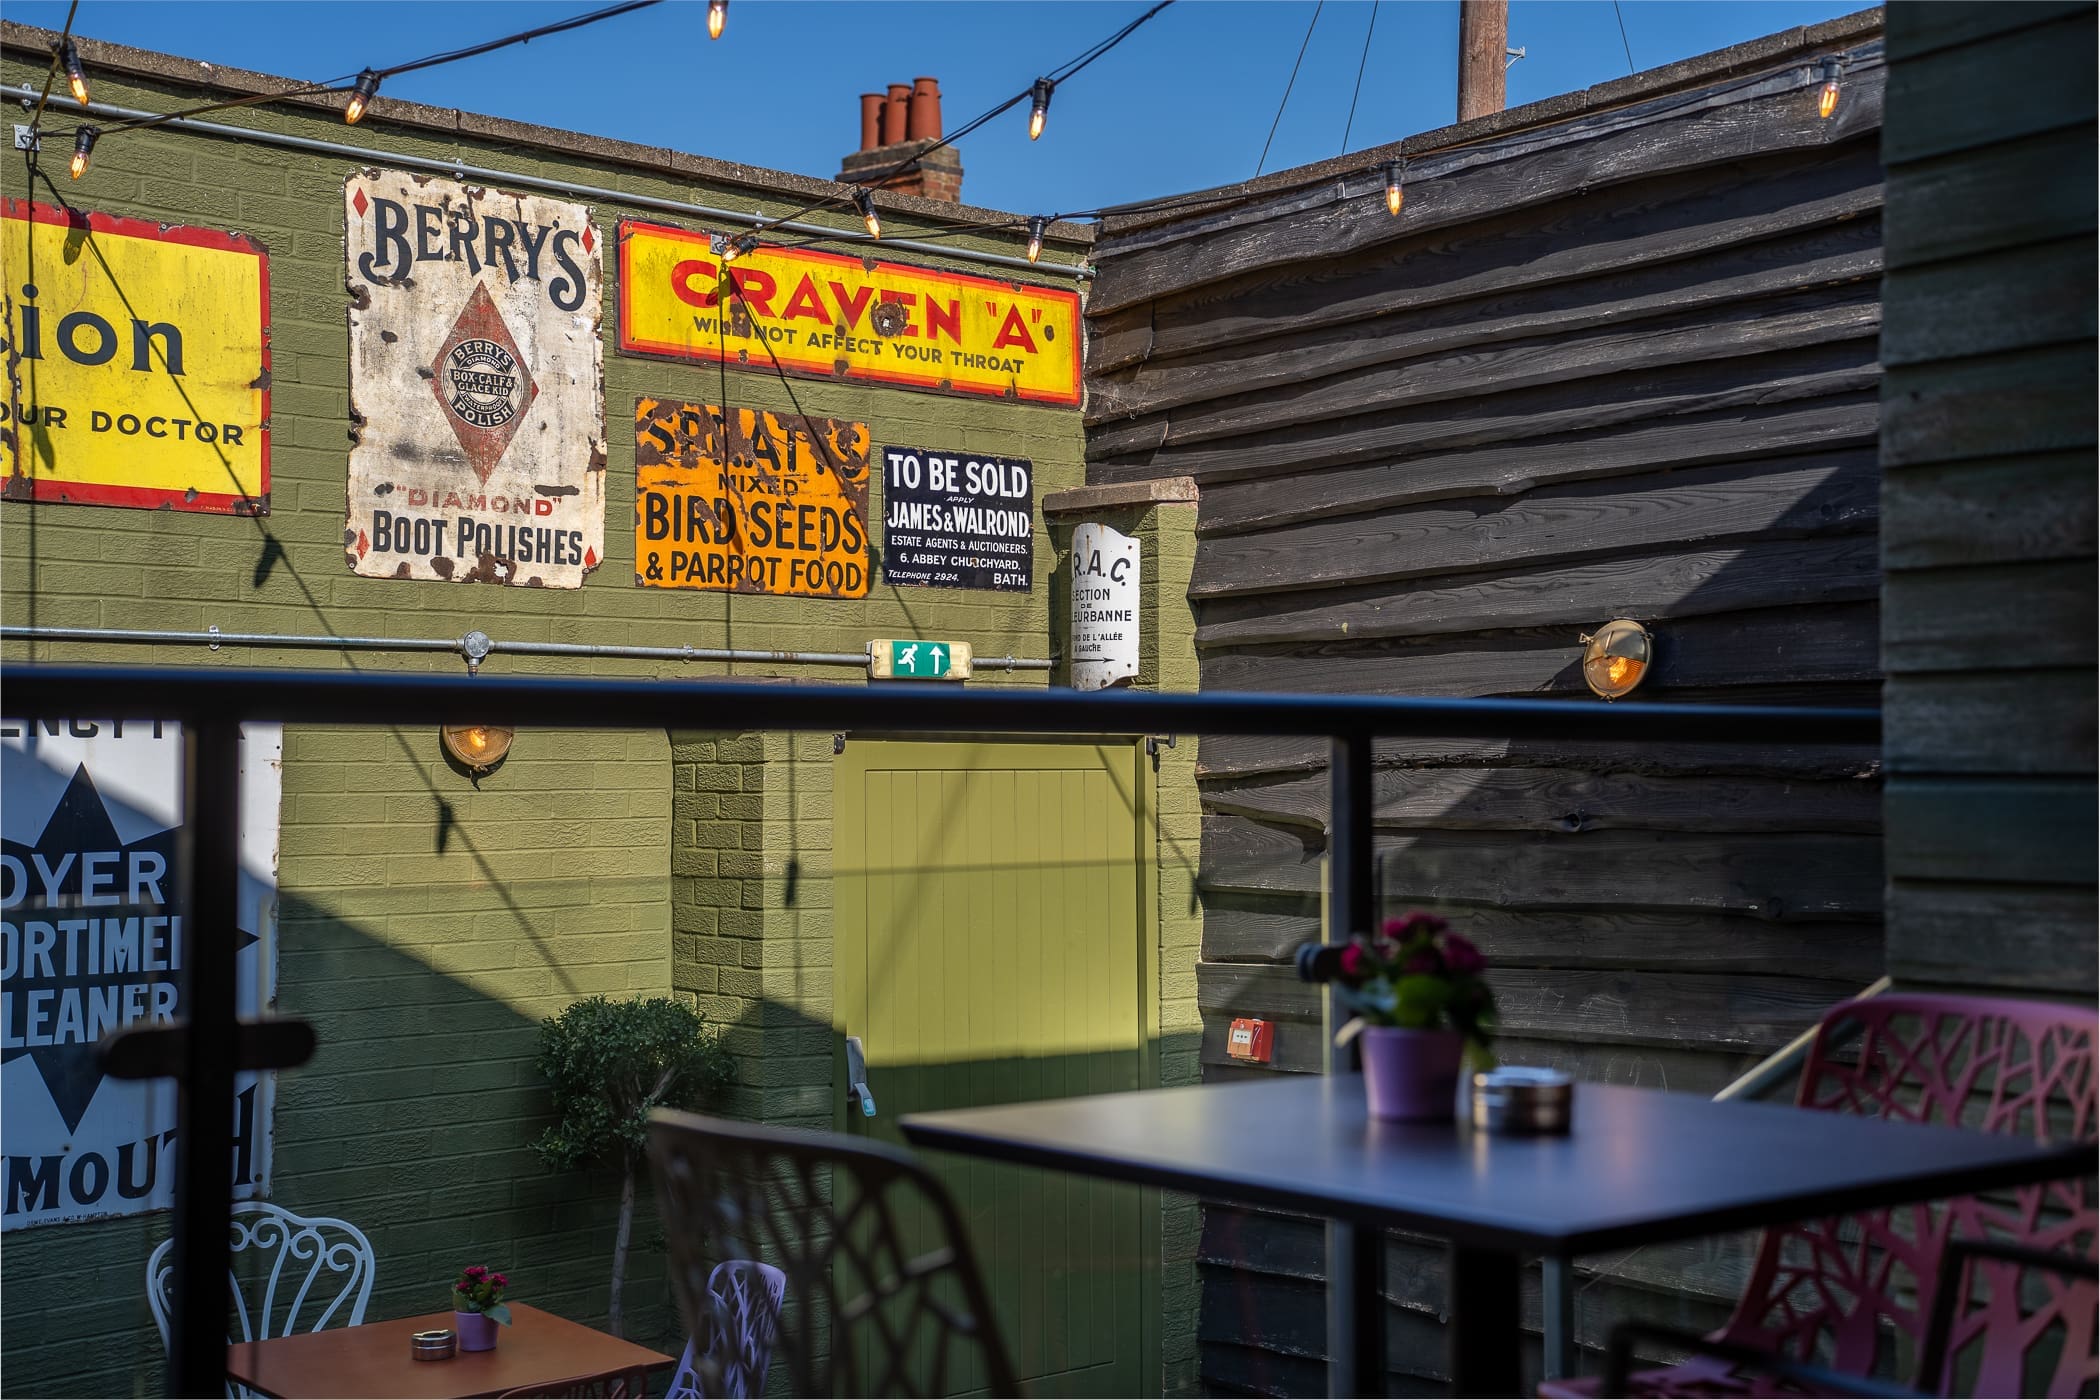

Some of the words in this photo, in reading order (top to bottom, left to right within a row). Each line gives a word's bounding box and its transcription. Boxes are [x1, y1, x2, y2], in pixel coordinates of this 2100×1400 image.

[358, 195, 587, 312] BERRY'S
[671, 258, 962, 347] CRAVEN
[985, 301, 1043, 354] "A"
[455, 341, 511, 366] BERRY'S
[466, 355, 501, 369] DIAMOND
[754, 324, 797, 345] NOT
[807, 331, 883, 356] AFFECT
[892, 342, 943, 363] YOUR
[950, 350, 1024, 374] THROAT
[458, 381, 490, 394] GLACE
[492, 386, 509, 396] KID
[91, 410, 244, 446] DOCTOR
[455, 401, 513, 426] POLISH
[718, 473, 799, 496] MIXED
[887, 453, 921, 490] TO
[928, 457, 960, 493] BE
[965, 461, 1028, 498] SOLD
[372, 509, 448, 556] BOOT
[457, 516, 583, 566] POLISHES
[645, 491, 737, 545] BIRD
[750, 500, 862, 555] SEEDS
[891, 535, 922, 547] ESTATE
[925, 537, 959, 550] AGENTS
[960, 541, 967, 550] &
[968, 540, 1028, 555] AUCTIONEERS.
[912, 553, 947, 566] ABBEY
[645, 551, 664, 581] &
[671, 550, 782, 587] PARROT
[790, 558, 862, 592] FOOD
[993, 572, 1028, 586] BATH.
